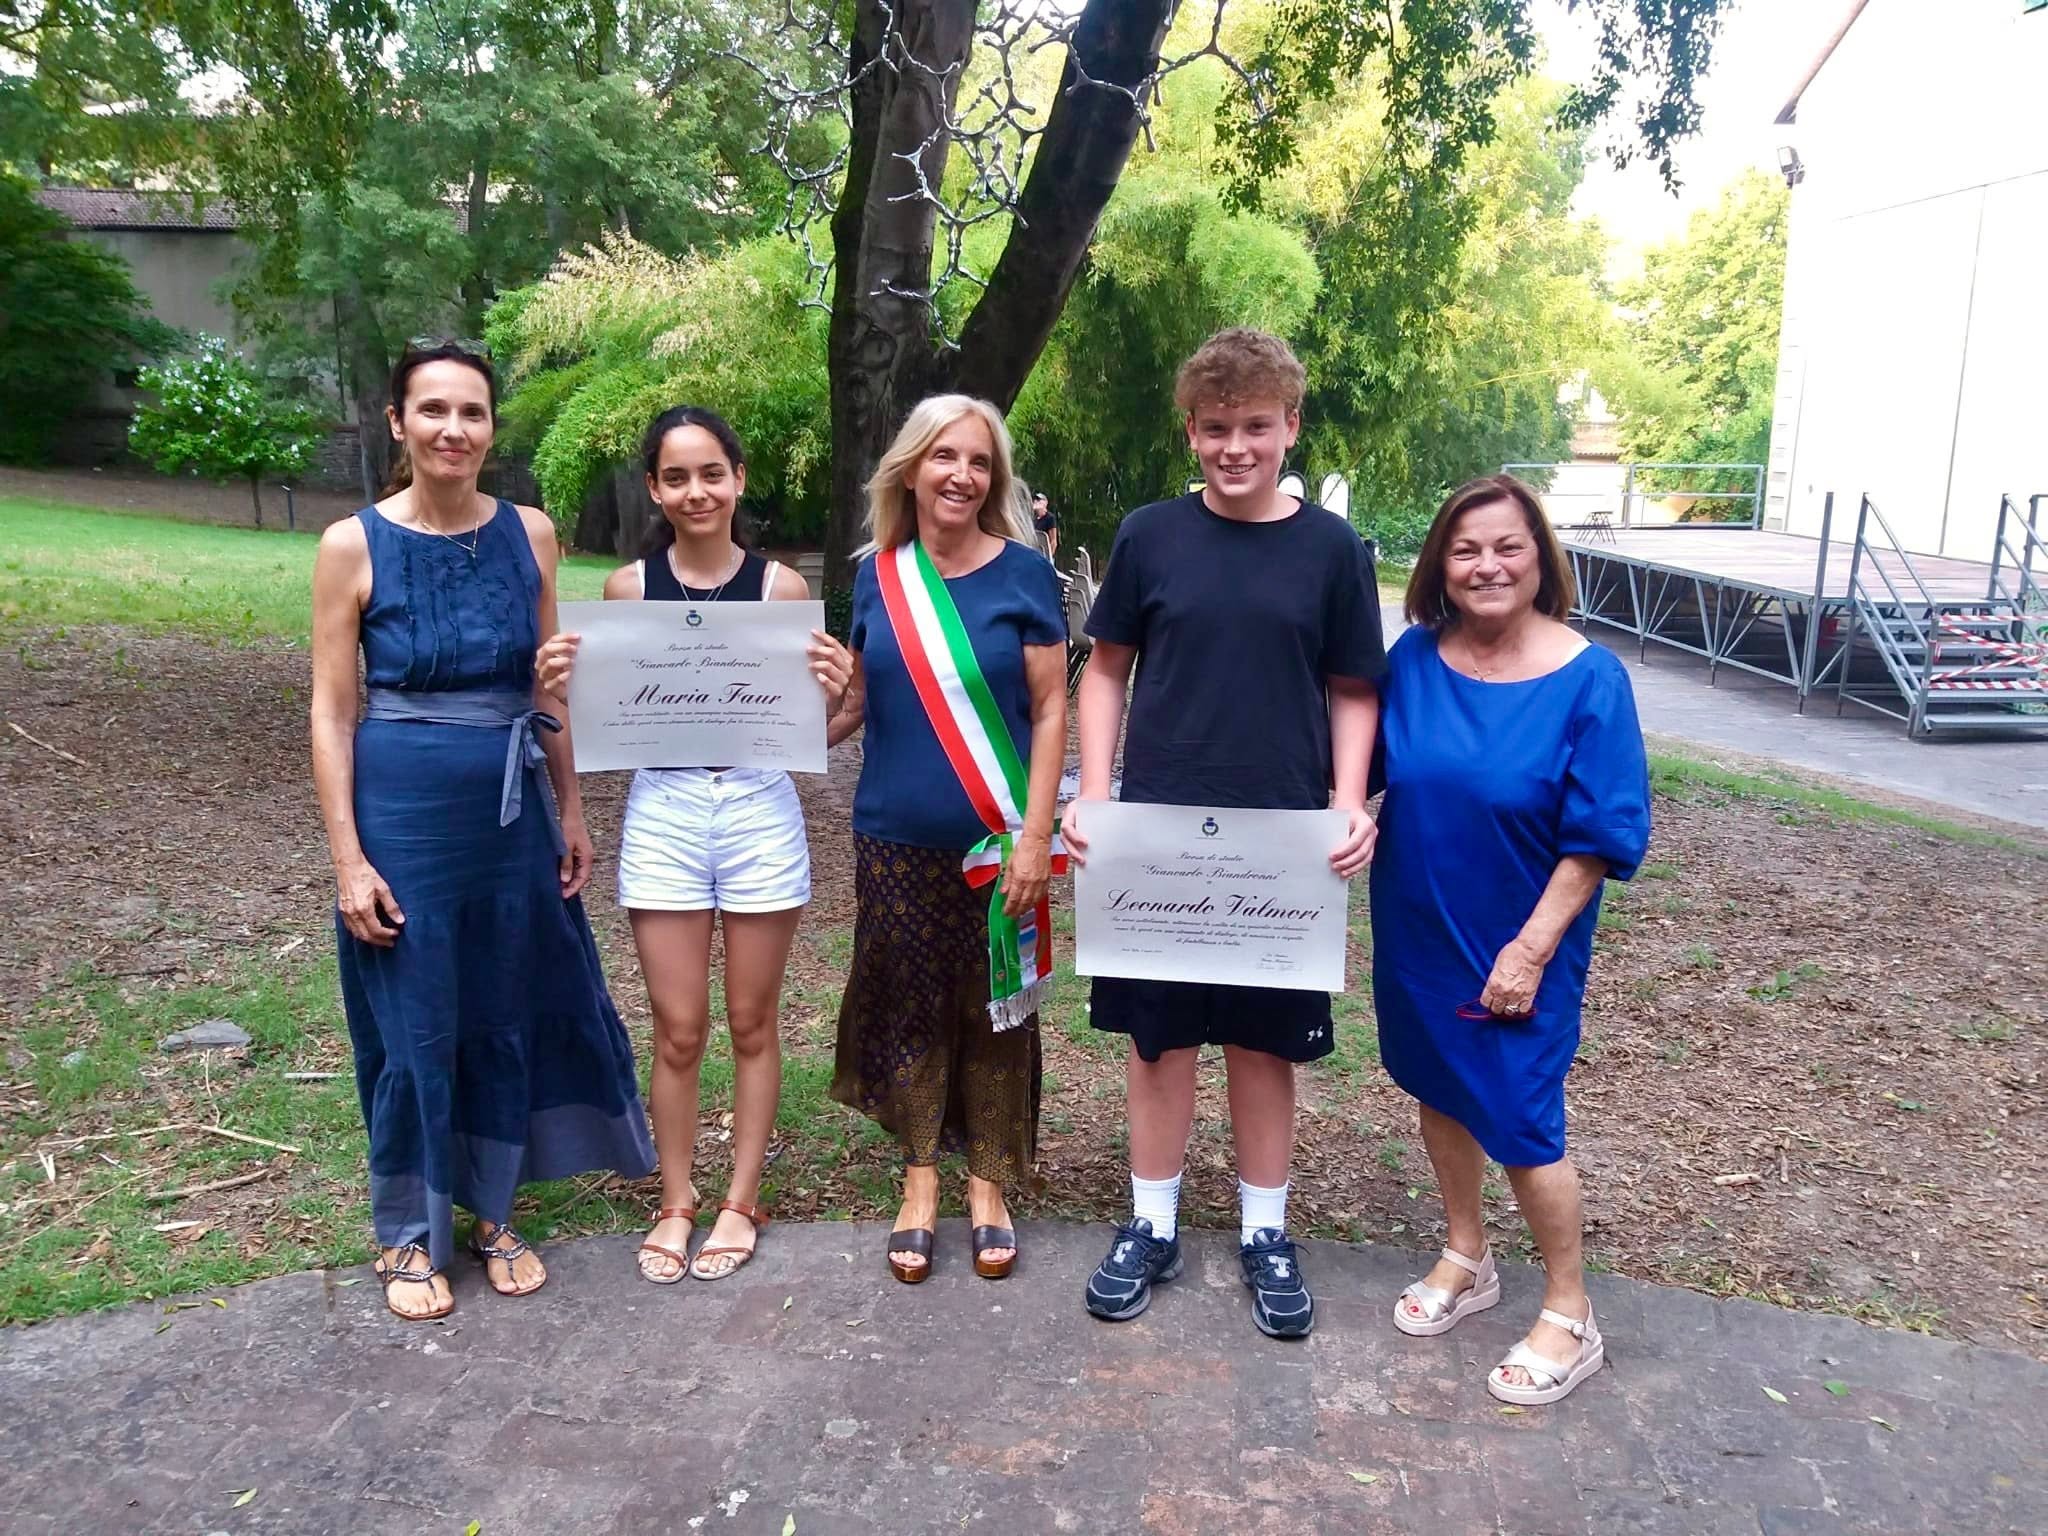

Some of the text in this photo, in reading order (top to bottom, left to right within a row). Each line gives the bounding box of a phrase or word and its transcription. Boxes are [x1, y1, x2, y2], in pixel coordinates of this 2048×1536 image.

[619, 682, 782, 706] Maria Faur
[1104, 888, 1325, 922] Leonardo Valmori
